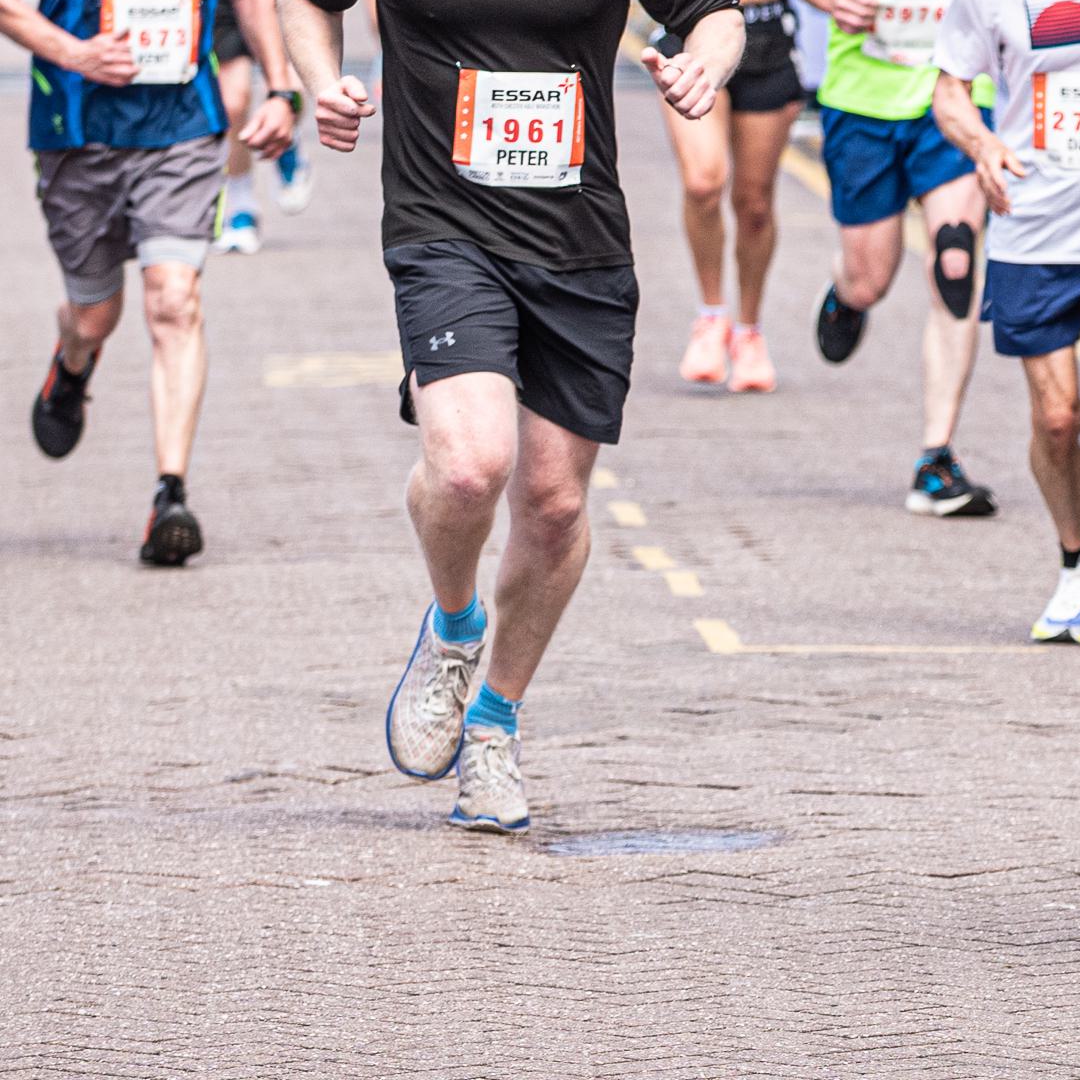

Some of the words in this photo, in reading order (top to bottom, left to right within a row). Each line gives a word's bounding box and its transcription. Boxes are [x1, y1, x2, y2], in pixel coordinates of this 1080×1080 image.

[492, 90, 561, 102] ESSAR
[483, 118, 563, 143] 1961
[497, 150, 548, 166] PETER
